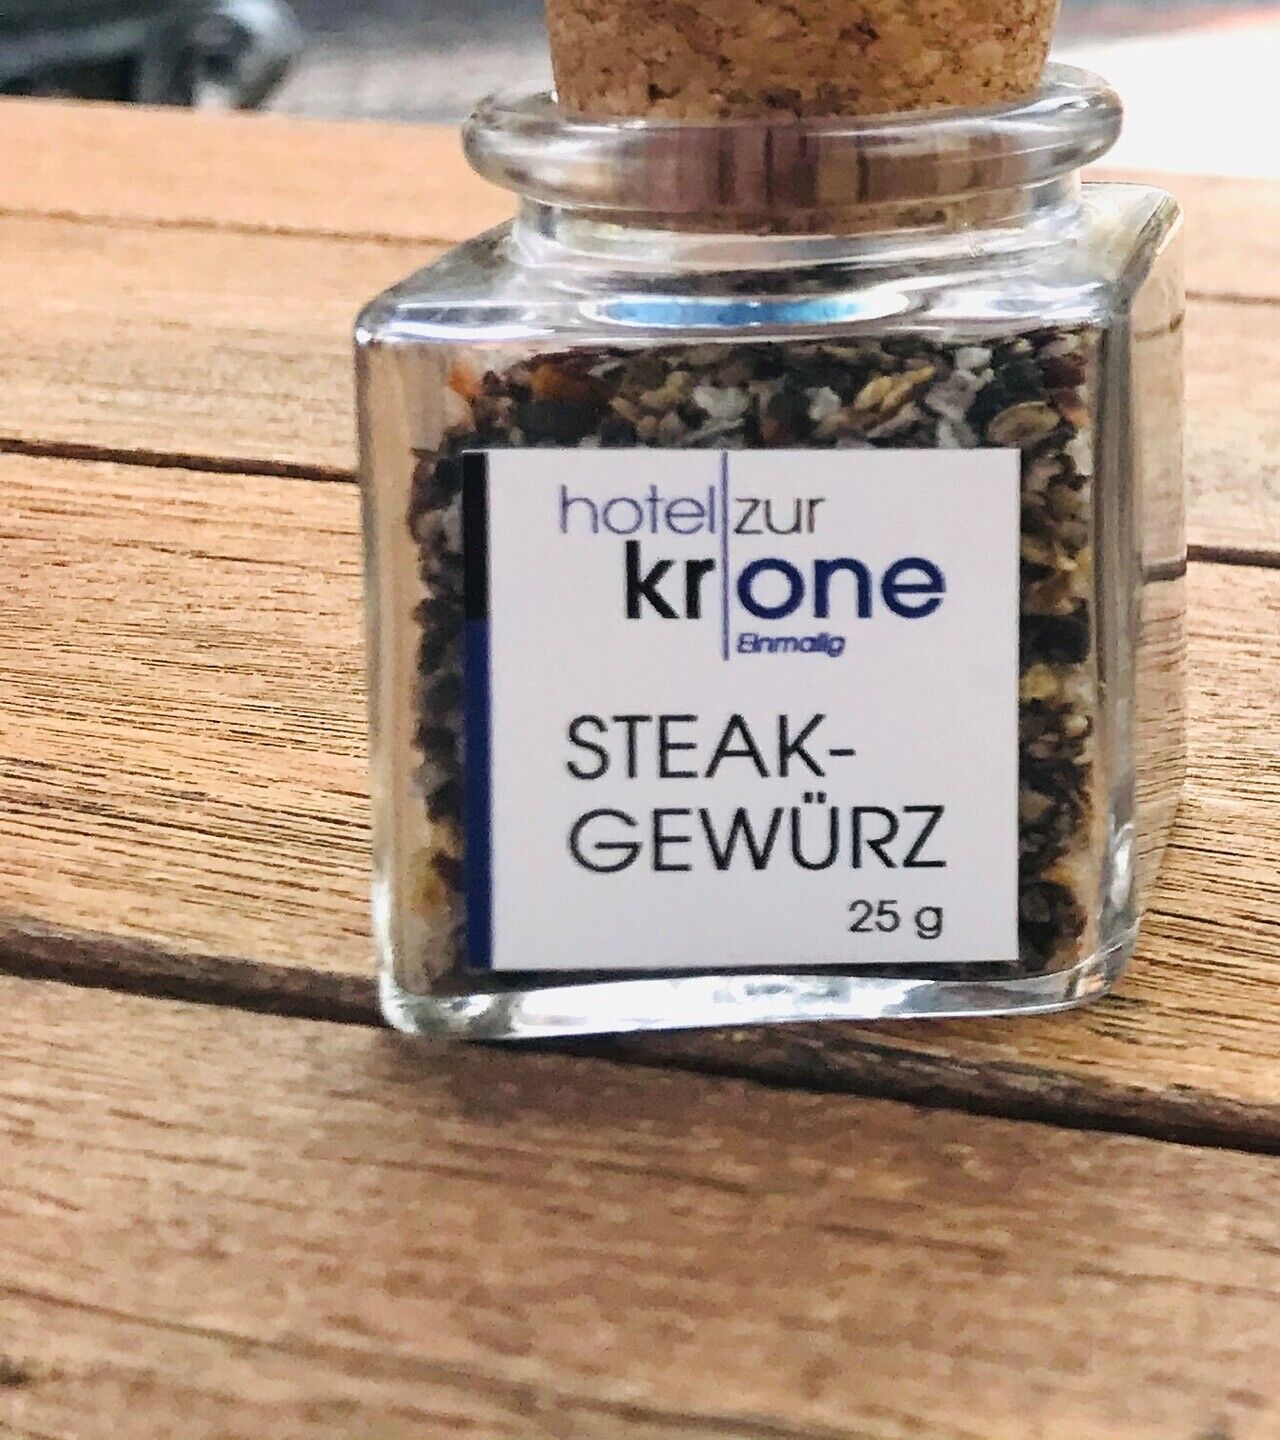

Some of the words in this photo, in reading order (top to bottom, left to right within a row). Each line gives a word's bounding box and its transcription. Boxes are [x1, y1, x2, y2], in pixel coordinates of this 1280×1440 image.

[560, 485, 715, 535] hotel
[733, 498, 825, 535] zur
[737, 633, 845, 657] Einmalig
[566, 713, 856, 780] STEAK-
[567, 791, 947, 874] GEWÜRZ
[848, 899, 901, 933] 25
[914, 906, 943, 940] g
